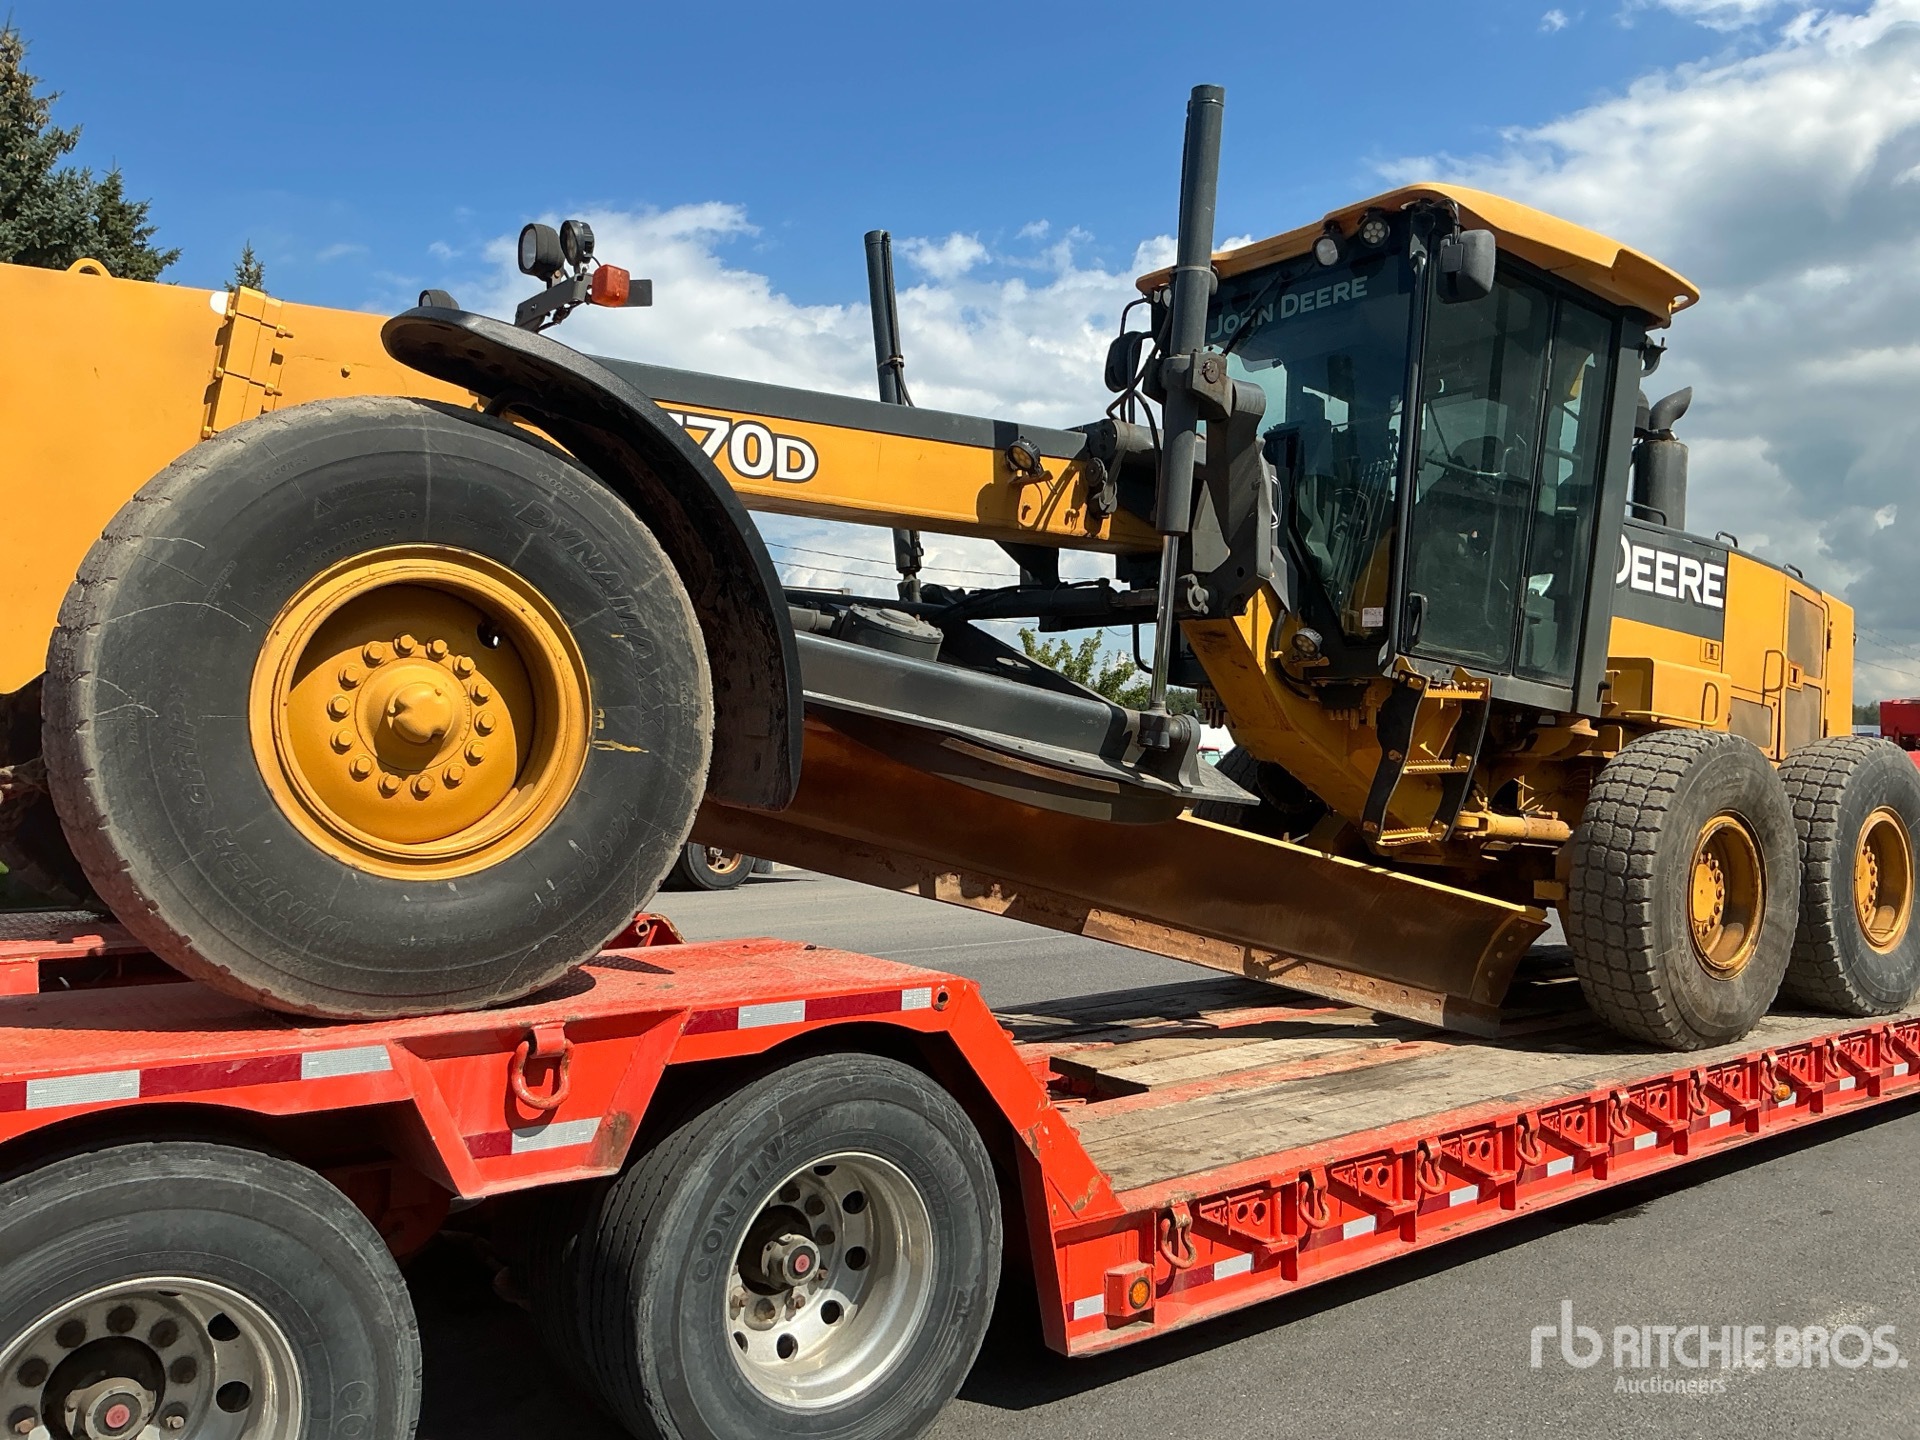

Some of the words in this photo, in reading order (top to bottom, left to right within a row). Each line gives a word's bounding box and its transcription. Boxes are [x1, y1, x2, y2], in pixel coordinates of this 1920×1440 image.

[1280, 275, 1368, 319] DEERE
[667, 411, 818, 483] 70D
[514, 499, 665, 733] DYNAMAXX
[692, 1107, 877, 1284] CONTINENTAL
